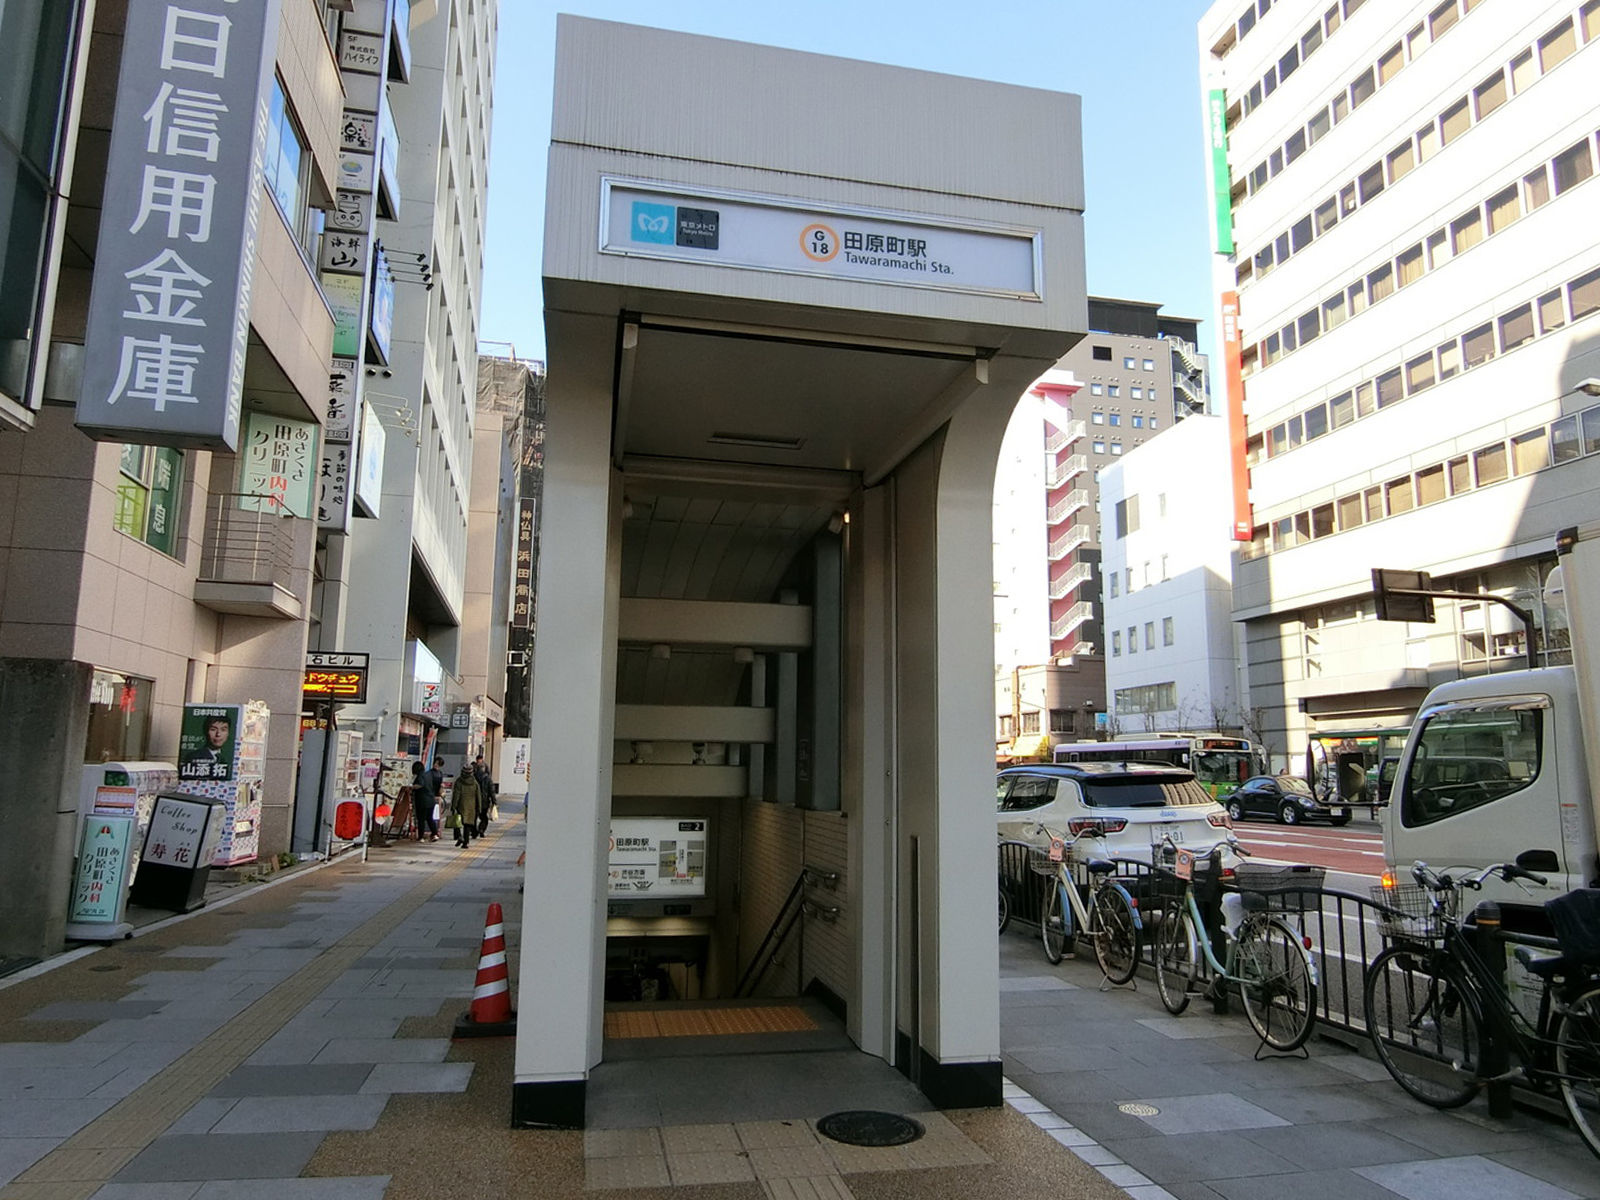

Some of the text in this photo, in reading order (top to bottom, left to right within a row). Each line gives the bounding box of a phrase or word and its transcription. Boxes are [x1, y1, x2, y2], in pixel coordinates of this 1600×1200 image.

[349, 45, 376, 55] 株式会社
[344, 53, 379, 65] ハイライフ
[107, 0, 240, 412] 日信用金庫
[680, 221, 716, 231] 東京メトロ
[682, 228, 697, 236] Tokyo
[814, 230, 825, 241] G
[811, 242, 829, 254] 18
[844, 231, 927, 258] 田原町駅
[228, 97, 269, 427] THE ASAHI SHINKIN BANK
[331, 251, 358, 267] 山
[844, 251, 955, 275] Tawaramachi Sta.
[292, 427, 309, 482] あさくさ
[250, 430, 269, 505] クリニック
[268, 424, 292, 508] 田原町内科
[515, 510, 532, 615] 神仏具 浜田商店
[305, 654, 354, 665] 石ビル
[304, 672, 360, 684] ドウチュウ
[193, 708, 227, 717] 日本共産党
[161, 805, 192, 818] Coffee
[171, 822, 198, 835] Shop
[694, 822, 701, 831] 2
[616, 838, 650, 846] 田原町駅
[106, 847, 120, 884] あさくさ
[79, 853, 94, 903] クリニック
[90, 847, 109, 903] 田原町内科
